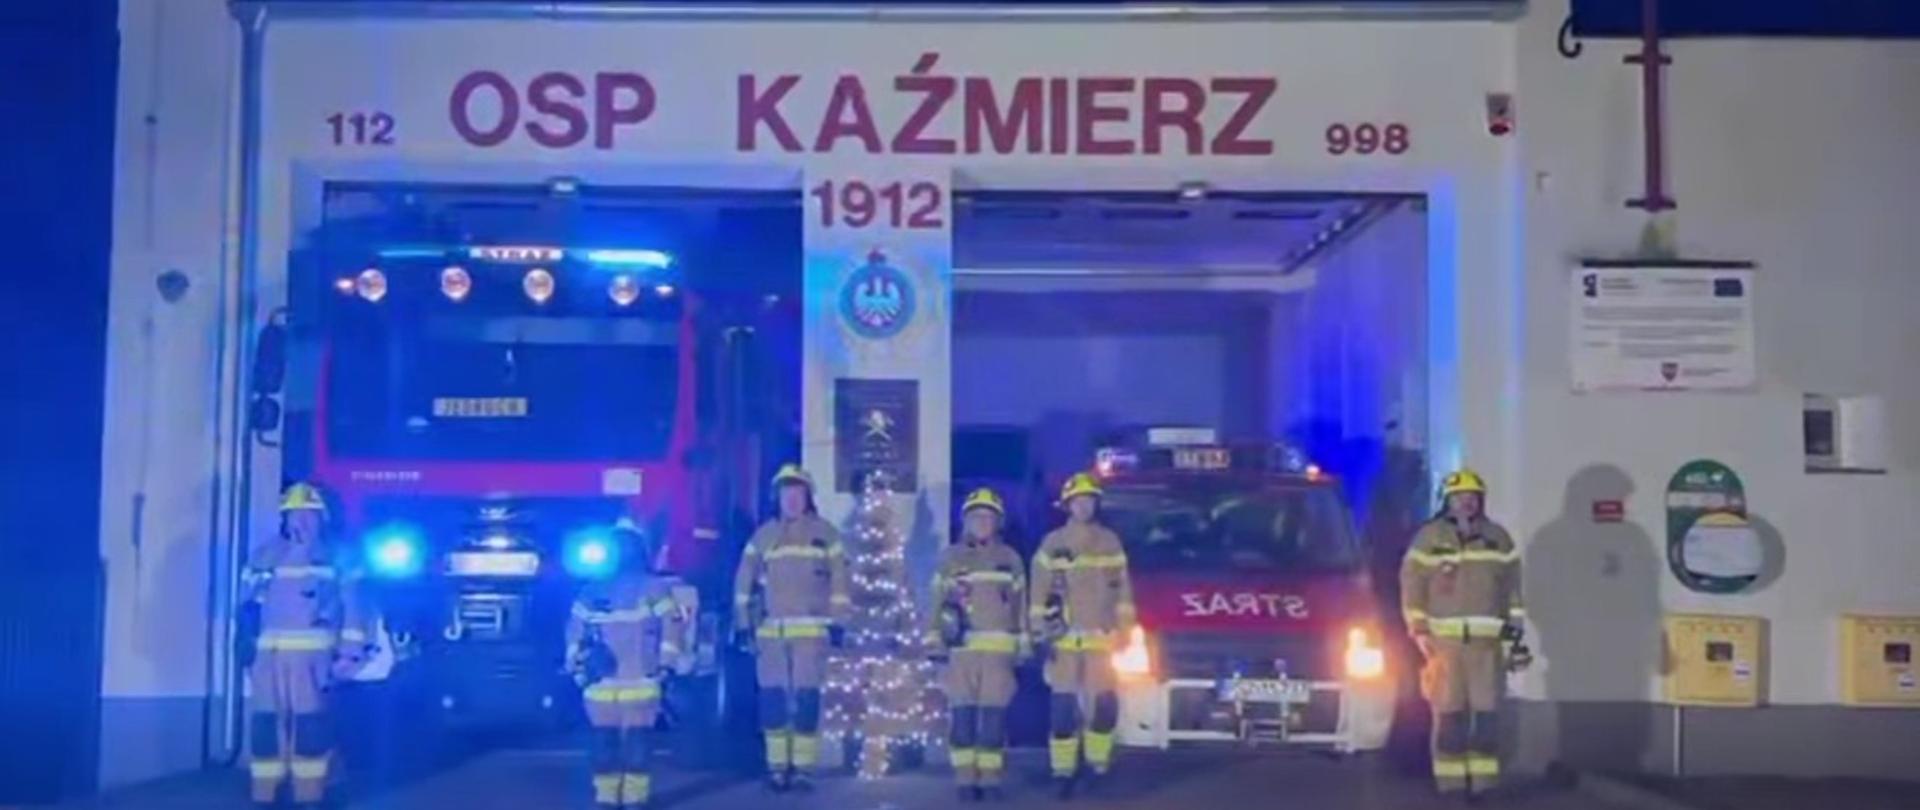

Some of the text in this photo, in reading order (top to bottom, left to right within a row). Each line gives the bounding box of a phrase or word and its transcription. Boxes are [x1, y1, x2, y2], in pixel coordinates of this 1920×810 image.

[449, 53, 1278, 157] OSP KAŹMIERZ
[326, 111, 396, 146] 112
[1325, 123, 1411, 156] 998
[811, 181, 944, 230] 1912
